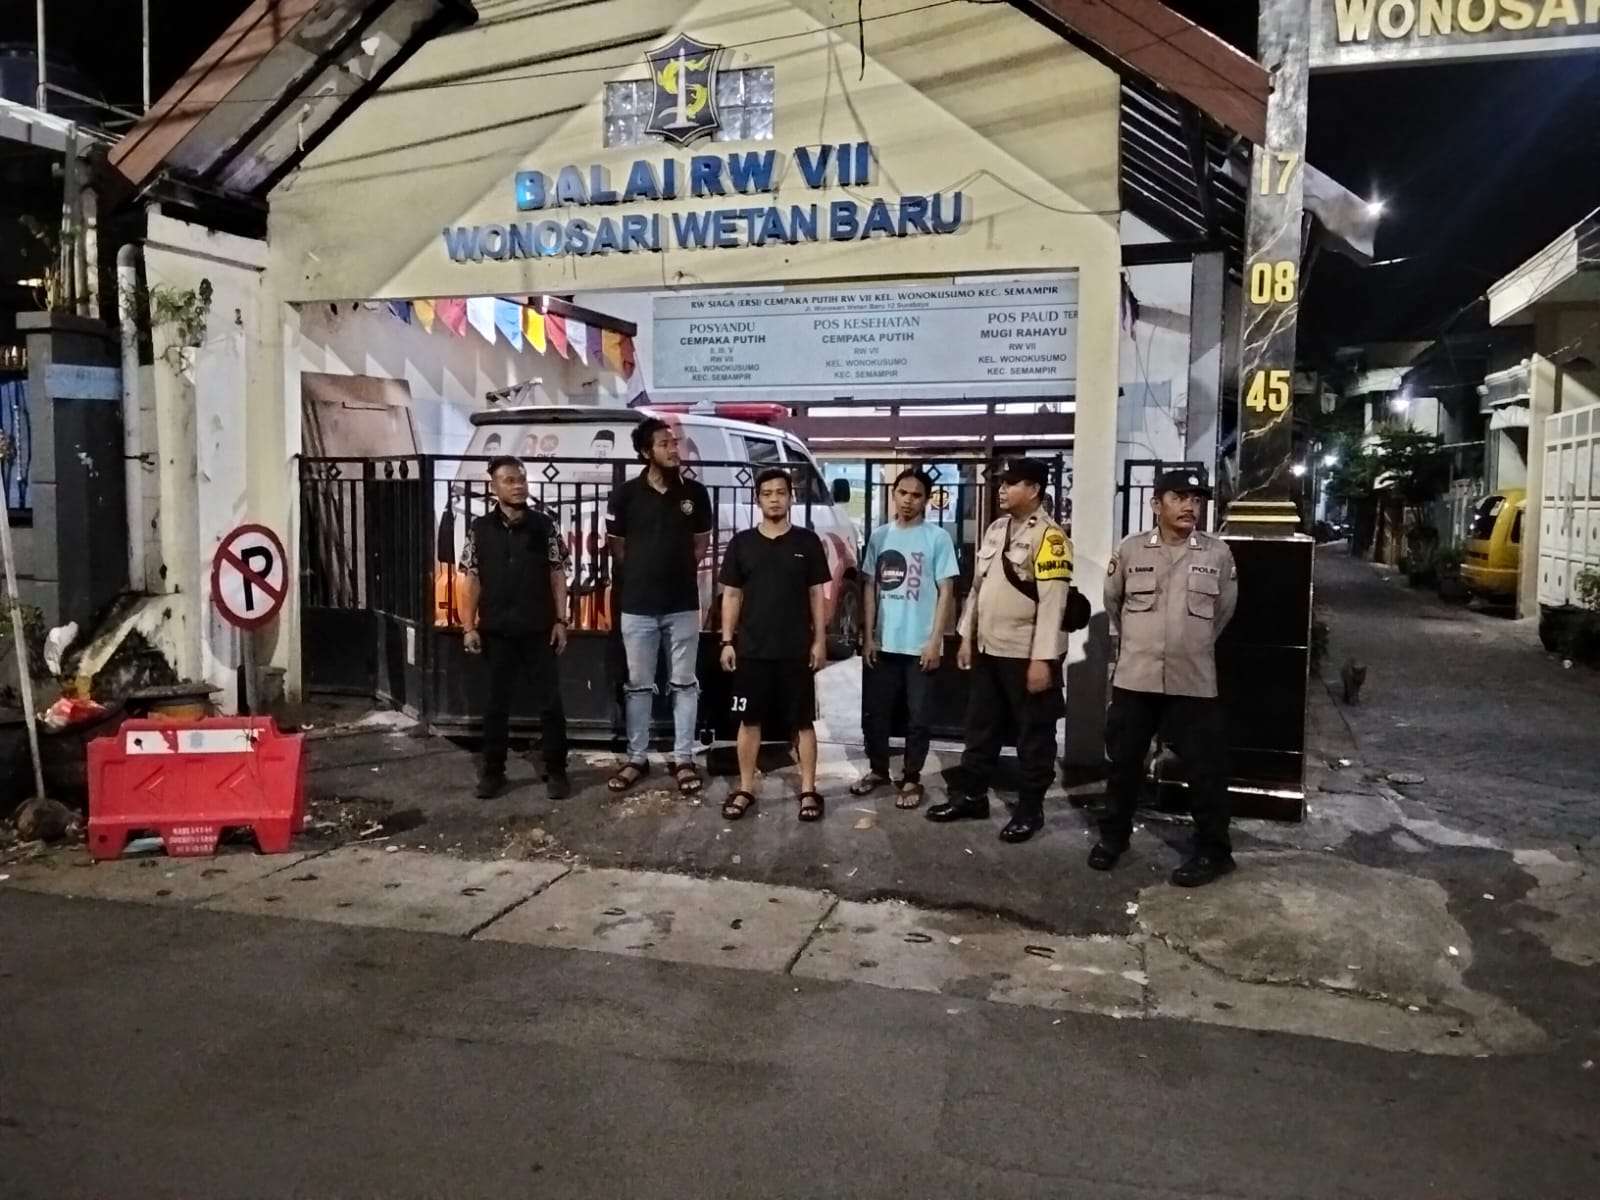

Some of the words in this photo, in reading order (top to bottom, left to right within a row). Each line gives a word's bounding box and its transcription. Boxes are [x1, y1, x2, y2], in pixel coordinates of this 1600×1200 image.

[515, 158, 675, 211] BALAI
[691, 150, 776, 197] RW
[794, 141, 870, 190] VII
[1260, 153, 1298, 195] 17
[443, 213, 662, 262] WONOSARI
[672, 203, 819, 248] WETAN
[830, 191, 963, 241] BARU
[1250, 261, 1296, 305] 08
[690, 301, 705, 309] RW
[708, 300, 735, 308] SIAGA
[764, 296, 809, 305] CEMPAKA
[812, 295, 838, 304] PUTIH
[841, 295, 856, 303] RW
[859, 294, 872, 302] VII
[875, 293, 894, 301] KEL.
[898, 290, 976, 300] WONOKUSUMO
[978, 289, 1001, 297] KEC.
[1004, 286, 1059, 295] SEMAMPIR
[814, 319, 840, 330] POS
[844, 316, 921, 329] KESEHATAN
[988, 312, 1017, 324] POS
[1021, 310, 1059, 323] PAUD
[690, 322, 756, 334] POSYANDU
[980, 329, 1013, 339] MUGI
[1016, 327, 1068, 338] RAHAYU
[680, 336, 731, 346] CEMPAKA
[733, 335, 766, 344] PUTIH
[822, 334, 876, 344] CEMPAKA
[880, 333, 915, 342] PUTIH
[1009, 343, 1023, 351] RW
[846, 358, 908, 367] WONOKUSUMO
[1000, 354, 1068, 363] WONOKUSUMO
[703, 364, 760, 372] WONOKUSUMO
[855, 370, 899, 378] SEMAMPIR
[987, 367, 1007, 375] KEC.
[1010, 366, 1058, 375] SEMAMPIR
[711, 373, 752, 381] SEMAMPIR
[1246, 369, 1291, 413] 45
[241, 545, 273, 612] P
[906, 551, 924, 602] 2024
[731, 696, 748, 712] 13
